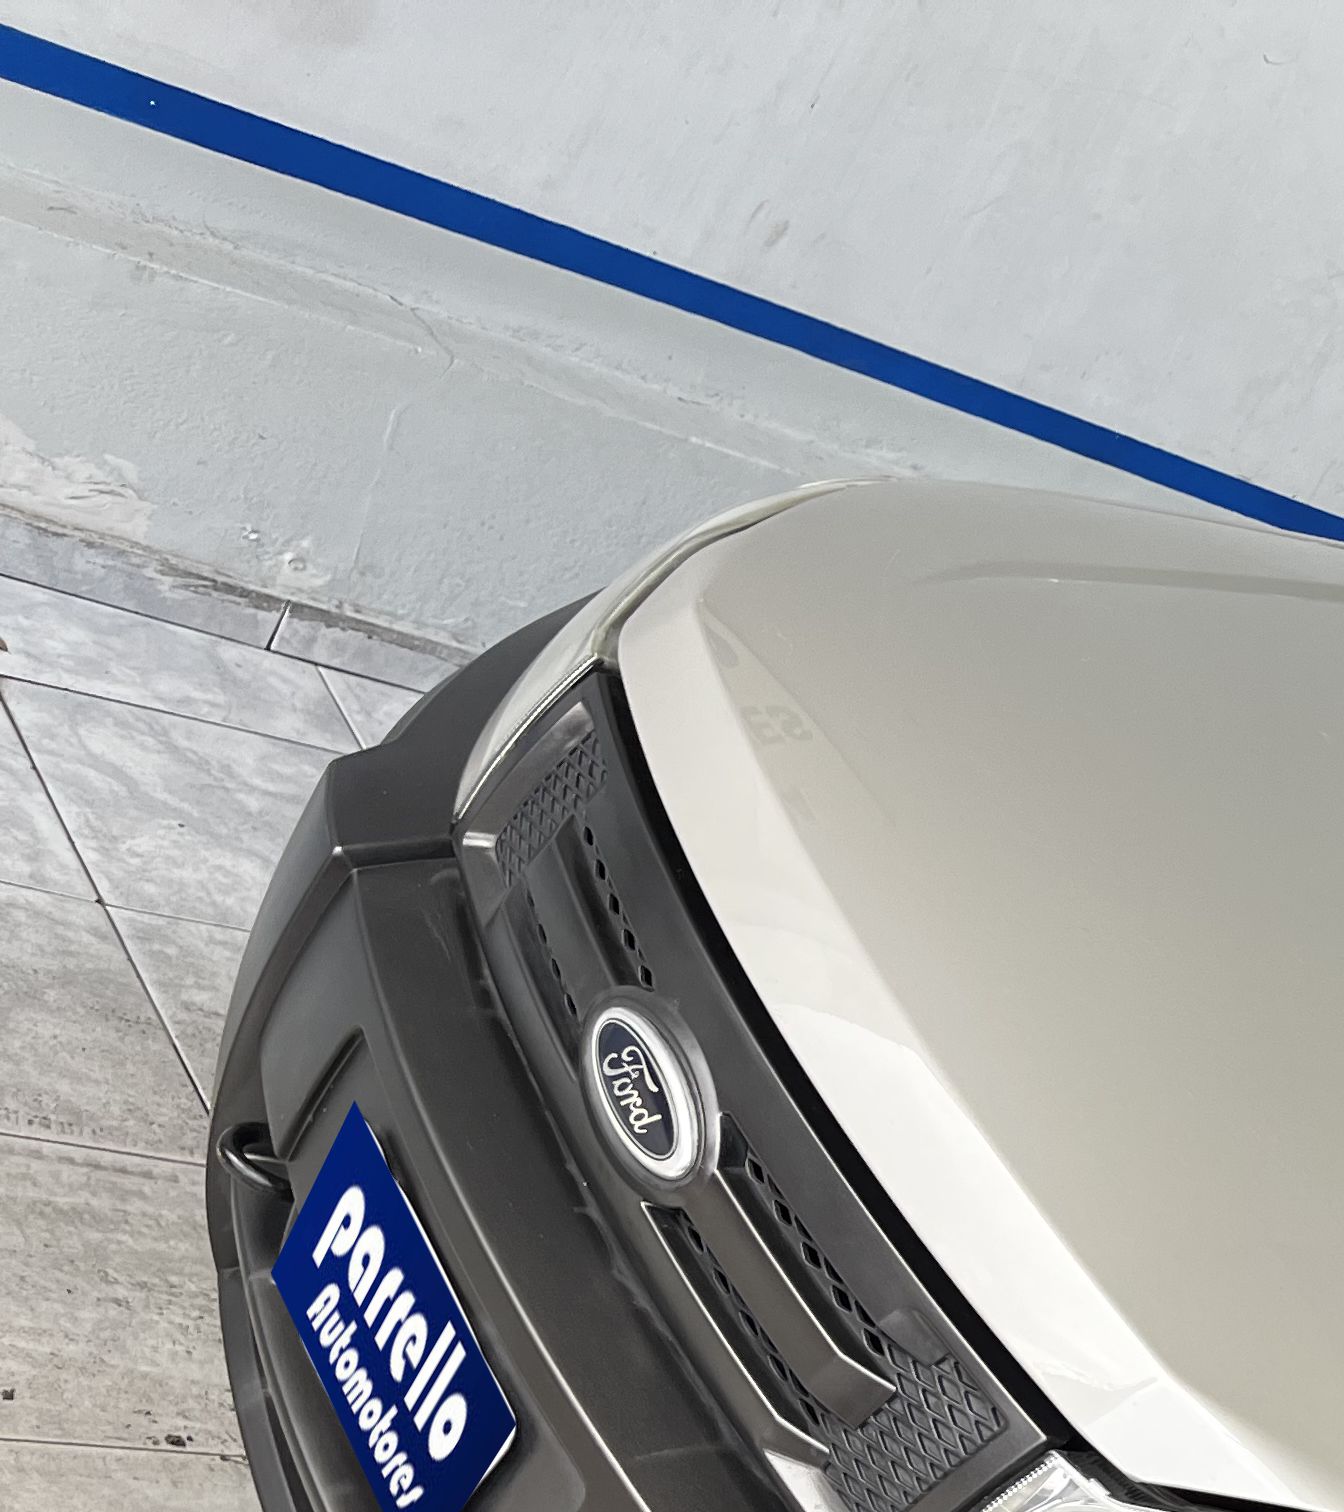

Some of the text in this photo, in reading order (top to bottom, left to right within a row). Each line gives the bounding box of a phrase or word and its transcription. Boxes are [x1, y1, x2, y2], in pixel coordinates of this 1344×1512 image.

[602, 1044, 663, 1135] Ford
[305, 1282, 425, 1509] Automotores
[312, 1184, 468, 1462] parrello
